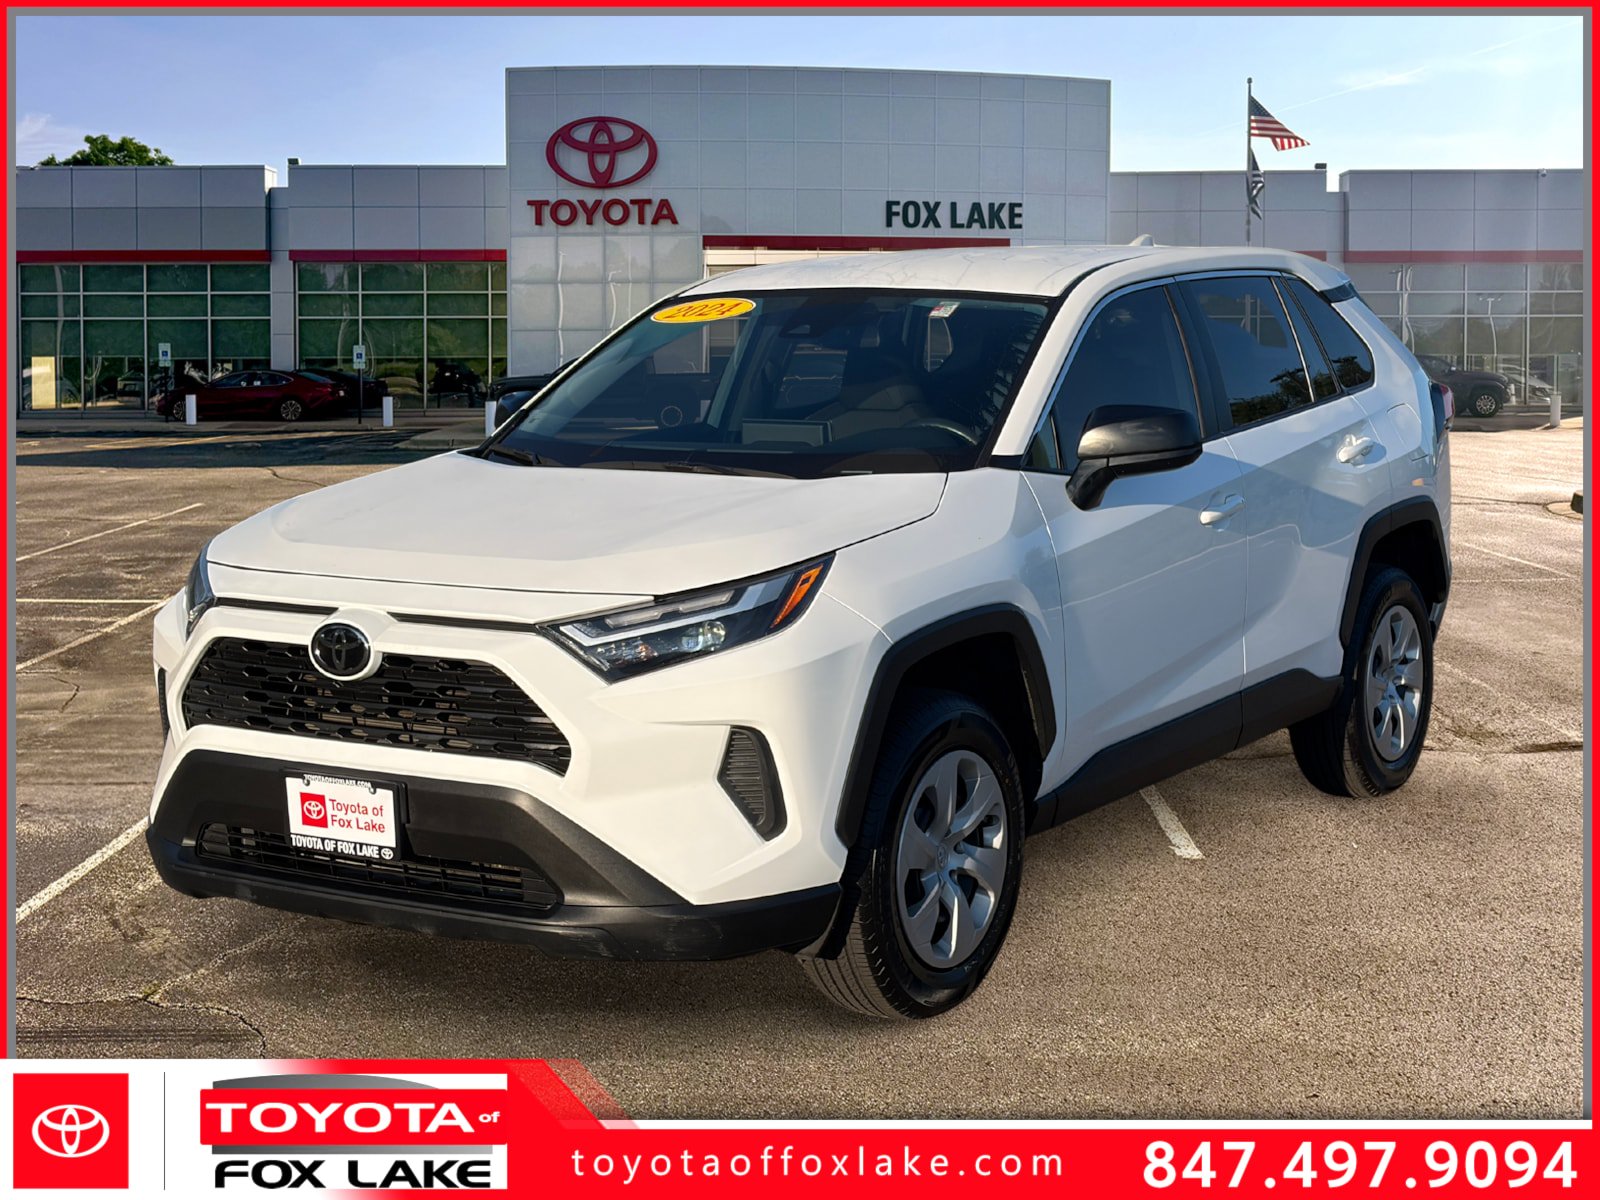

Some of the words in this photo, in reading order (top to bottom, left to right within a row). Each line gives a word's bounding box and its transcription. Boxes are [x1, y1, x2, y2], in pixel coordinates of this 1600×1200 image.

[527, 198, 679, 227] TOYOTA
[885, 200, 942, 228] FOX
[949, 201, 1023, 230] LAKE
[662, 301, 743, 319] 2024
[328, 798, 368, 816] Toyota
[372, 804, 384, 817] of
[331, 815, 352, 828] Fox
[356, 817, 386, 833] Lake
[291, 835, 322, 848] TOYOTA
[324, 840, 337, 850] OF
[337, 841, 355, 853] FOX
[356, 843, 380, 859] LAKE
